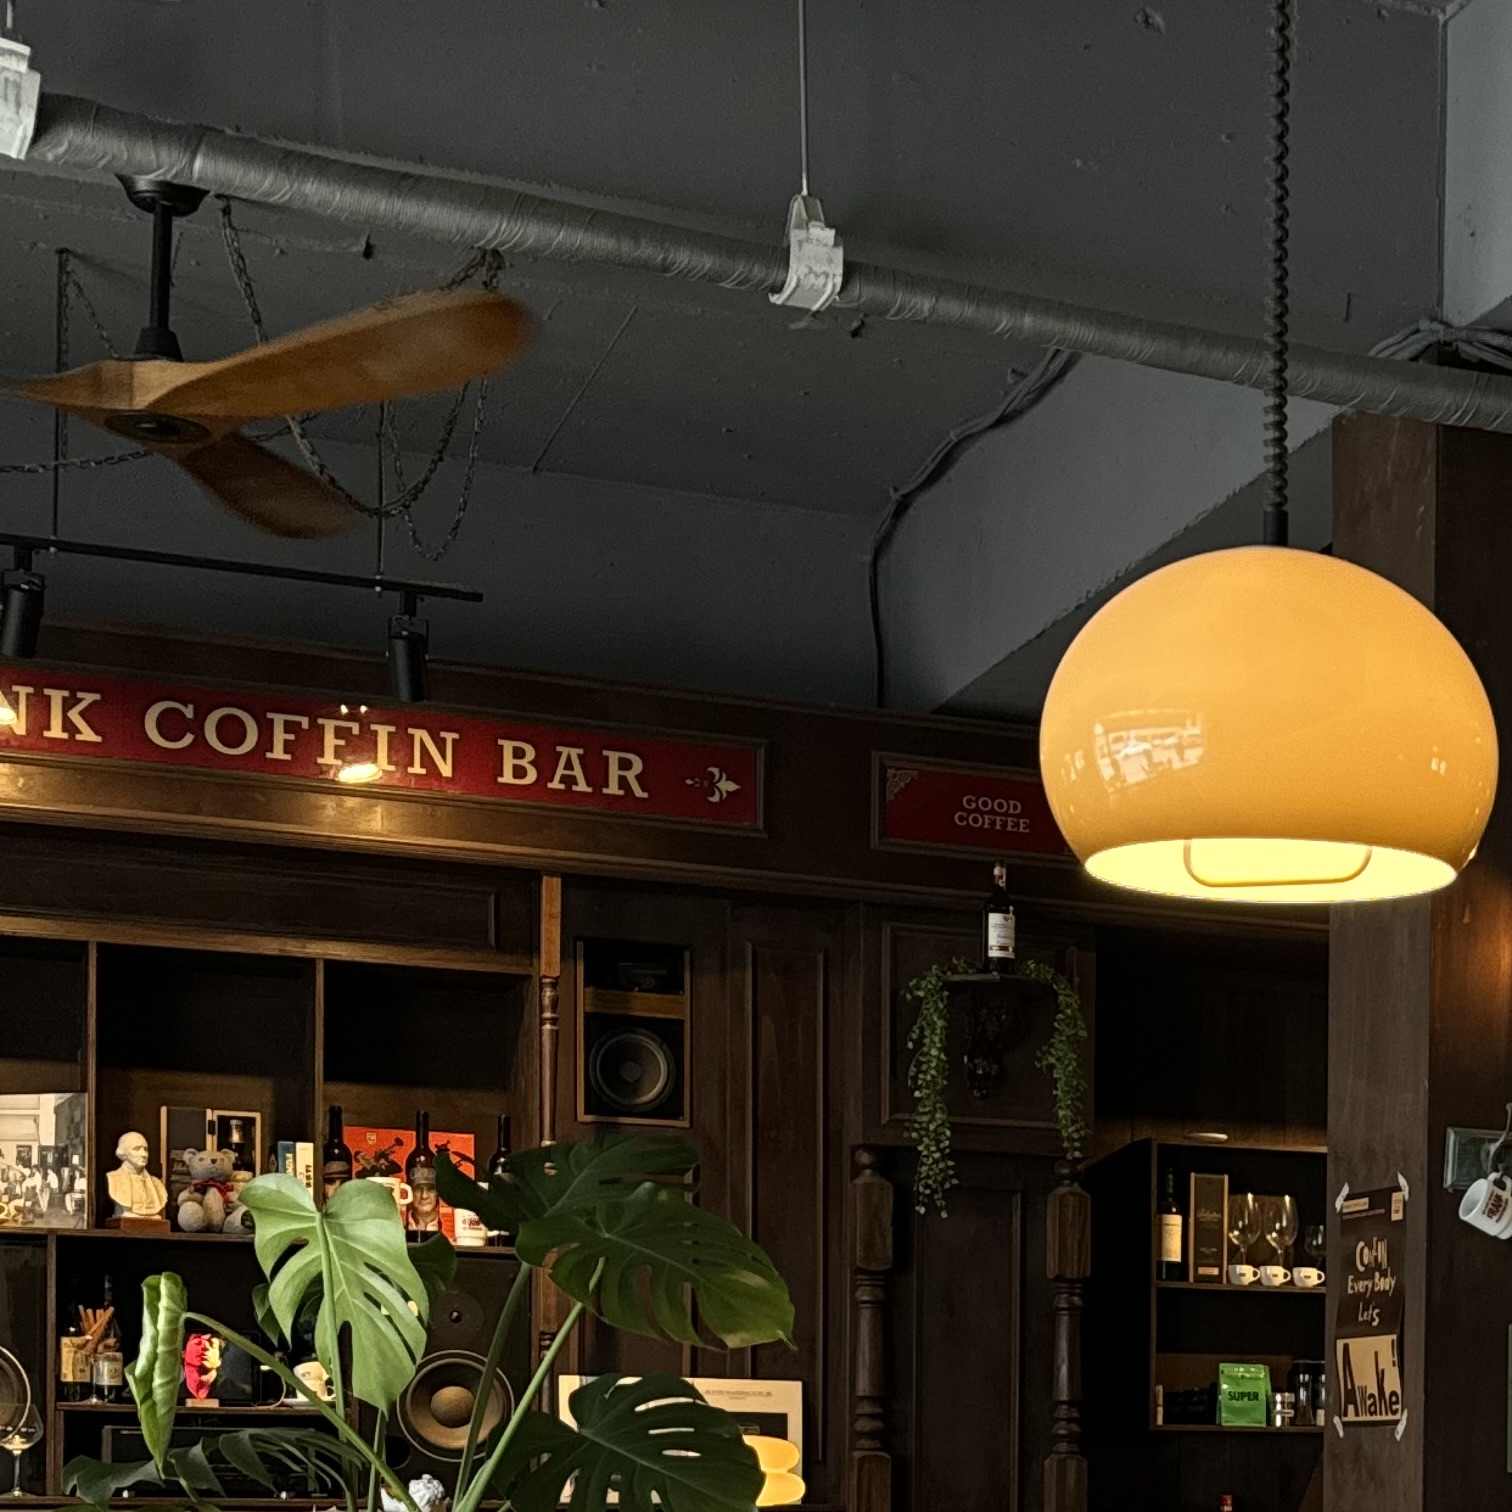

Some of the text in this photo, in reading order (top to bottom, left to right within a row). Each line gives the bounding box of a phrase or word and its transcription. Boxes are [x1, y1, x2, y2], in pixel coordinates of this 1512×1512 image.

[144, 700, 460, 778] COFFIN
[497, 738, 649, 799] BAR
[962, 795, 1022, 815] GOOD
[953, 811, 1031, 833] COFFEE
[1228, 1390, 1260, 1402] SUPER
